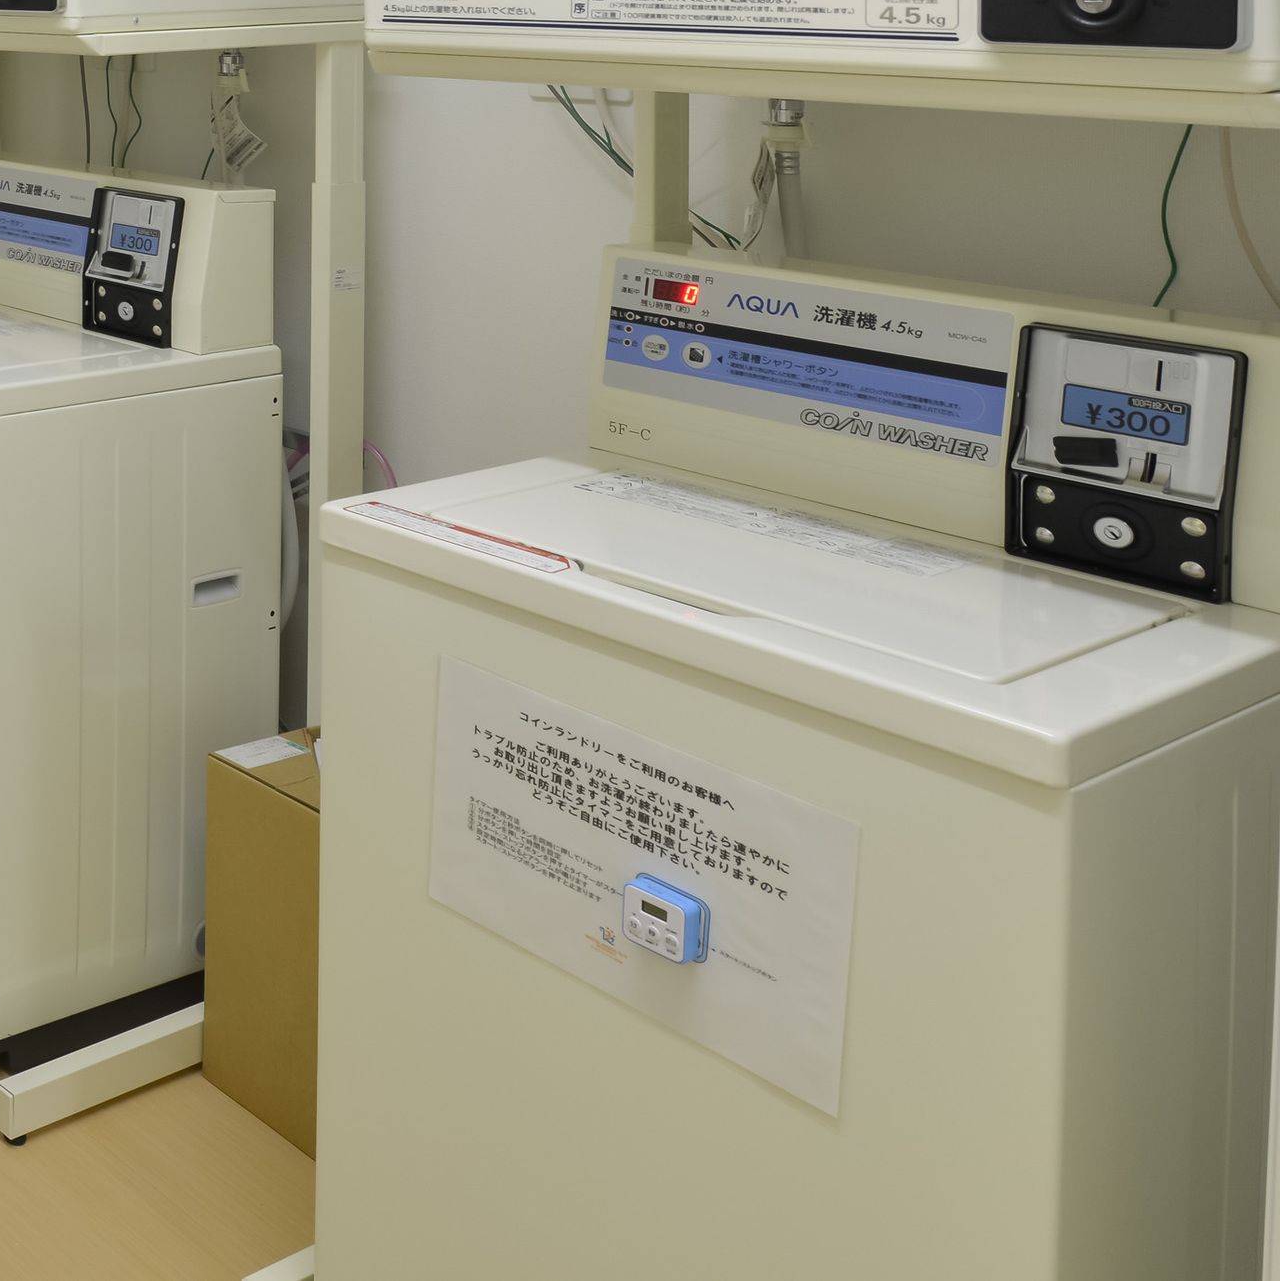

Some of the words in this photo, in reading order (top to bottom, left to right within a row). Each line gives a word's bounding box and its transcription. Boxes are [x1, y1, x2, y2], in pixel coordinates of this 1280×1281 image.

[383, 5, 537, 16] 4.5kg以上の洗濯物を入れないでください。
[879, 7, 922, 25] 4.5
[926, 14, 946, 27] kg
[16, 182, 43, 197] 洗濯機
[120, 233, 153, 252] ¥300
[7, 247, 37, 264] COIN
[38, 253, 83, 274] WASHER
[683, 285, 700, 304] 0
[705, 276, 714, 285] 円
[701, 309, 710, 318] 分
[727, 293, 800, 319] AQUA
[813, 303, 878, 332] 洗濯機
[881, 319, 924, 339] 4.5kg
[727, 350, 840, 378] 洗濯槽シャワーボタン
[1086, 402, 1171, 437] ¥300
[800, 408, 874, 438] COIN
[878, 423, 989, 462] WASHER
[519, 711, 736, 812] コインランドリーをご利用のお客様へ
[535, 741, 706, 825] ご利用ありがとうございます。
[472, 723, 791, 876] トラブル防止のため、お洗濯が終わりましたら速やかに
[493, 747, 752, 873] お取り出し頂きますようお願い申し上げます。
[471, 748, 790, 902] うっかり忘れ防止にタイマーをご用意しておりますので
